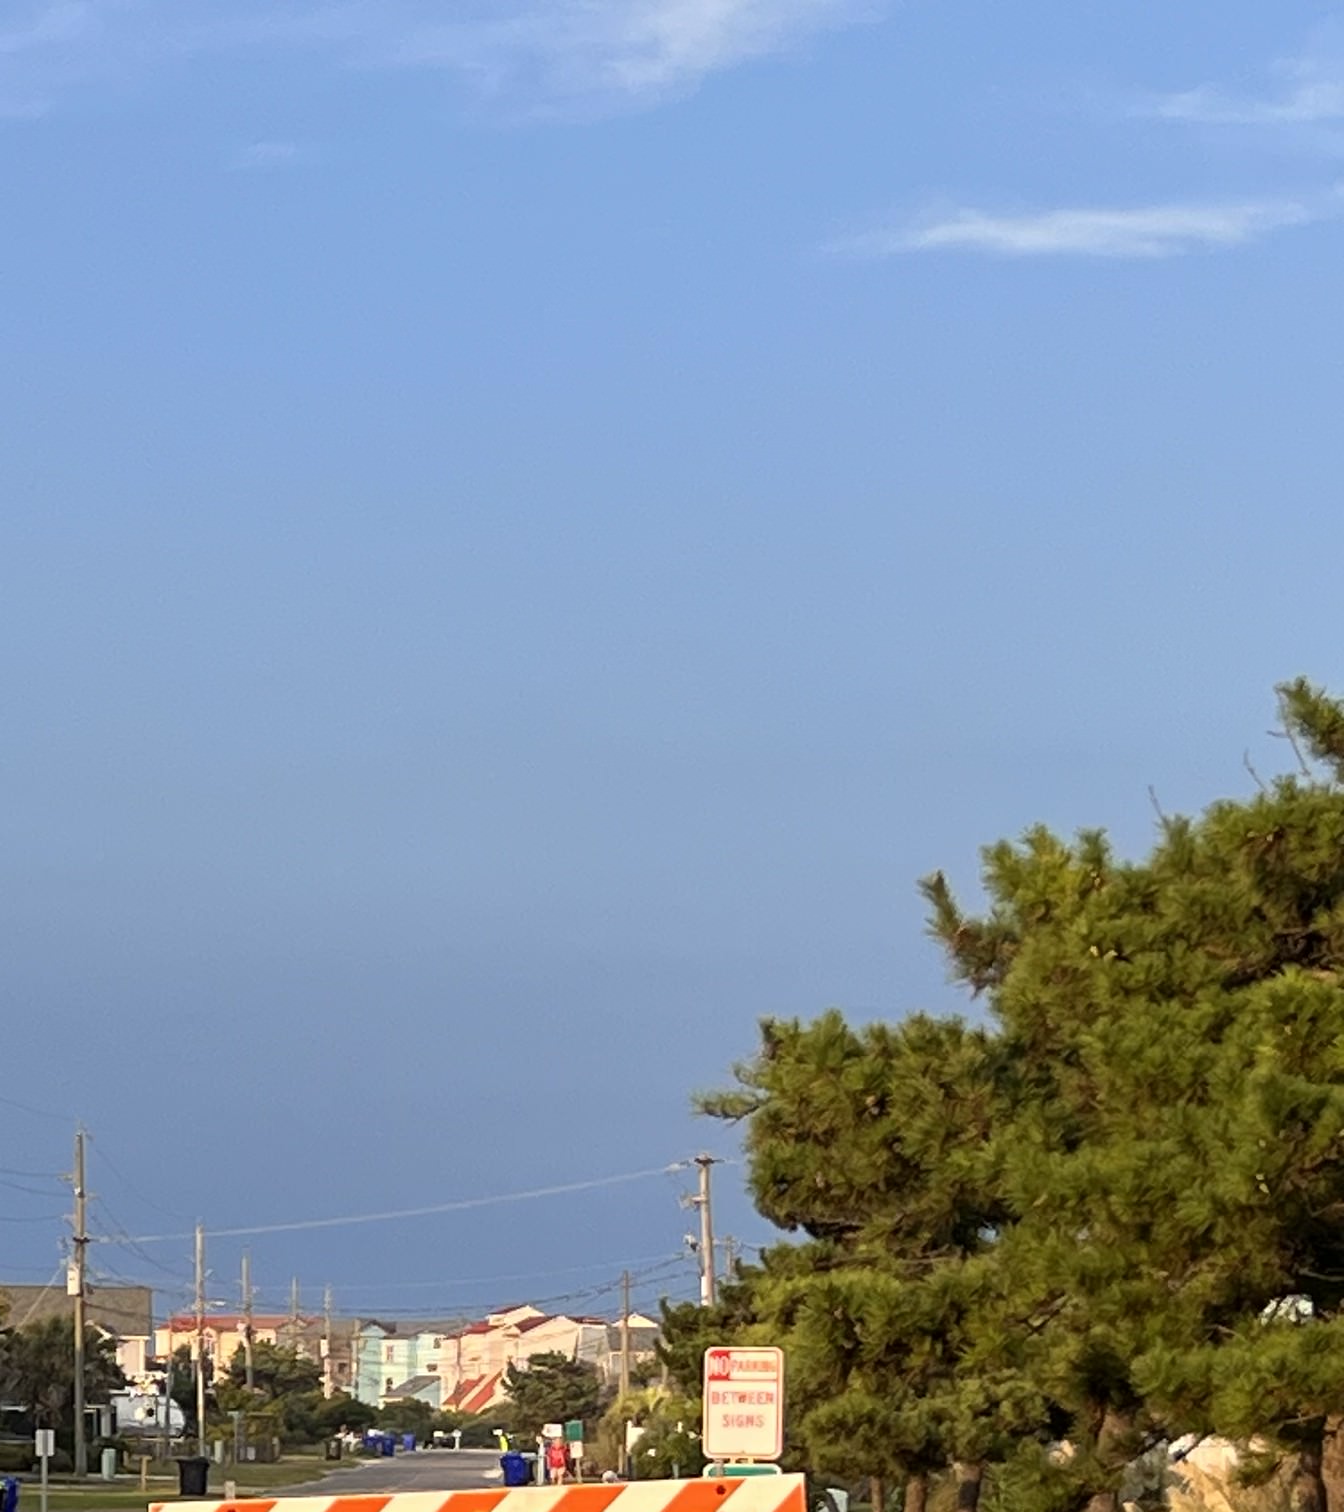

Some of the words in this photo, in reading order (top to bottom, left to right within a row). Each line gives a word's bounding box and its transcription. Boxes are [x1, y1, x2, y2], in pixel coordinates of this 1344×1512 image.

[707, 1355, 730, 1377] NO
[730, 1359, 777, 1373] PARKING
[711, 1391, 775, 1405] BETWEEN
[722, 1414, 766, 1429] SIGNS
